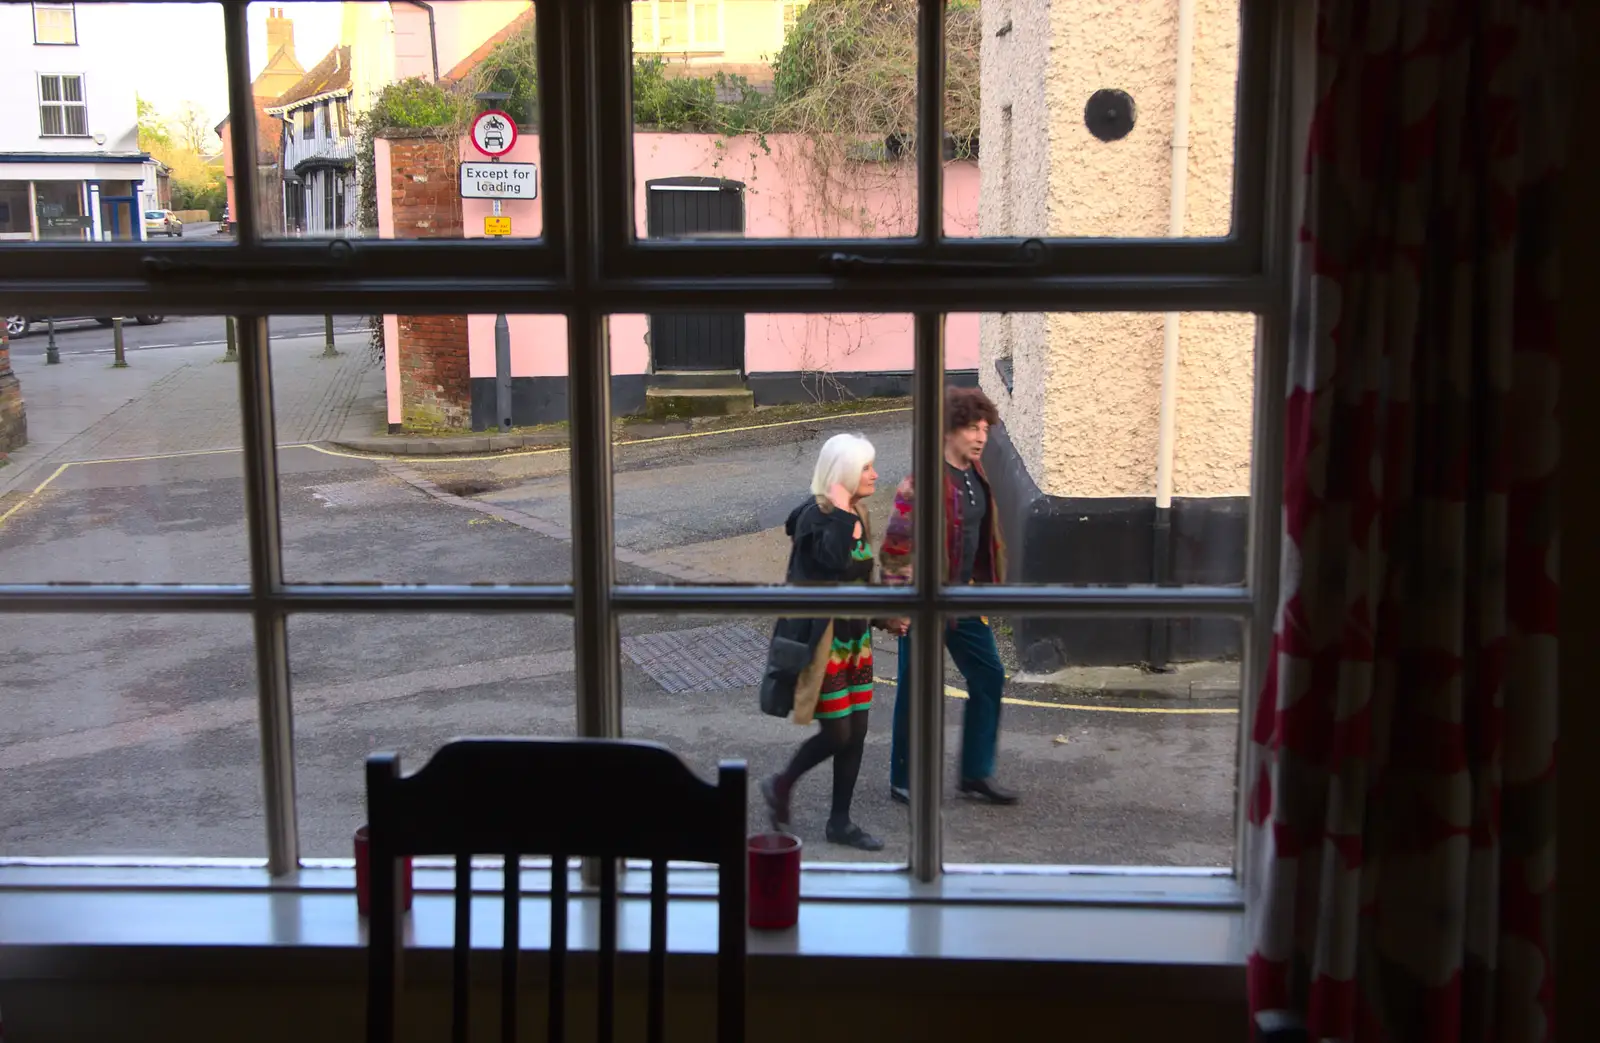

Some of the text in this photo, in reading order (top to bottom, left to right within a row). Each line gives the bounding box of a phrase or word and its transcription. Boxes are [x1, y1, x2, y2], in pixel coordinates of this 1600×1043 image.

[467, 168, 530, 180] Except for
[477, 181, 521, 194] loading
